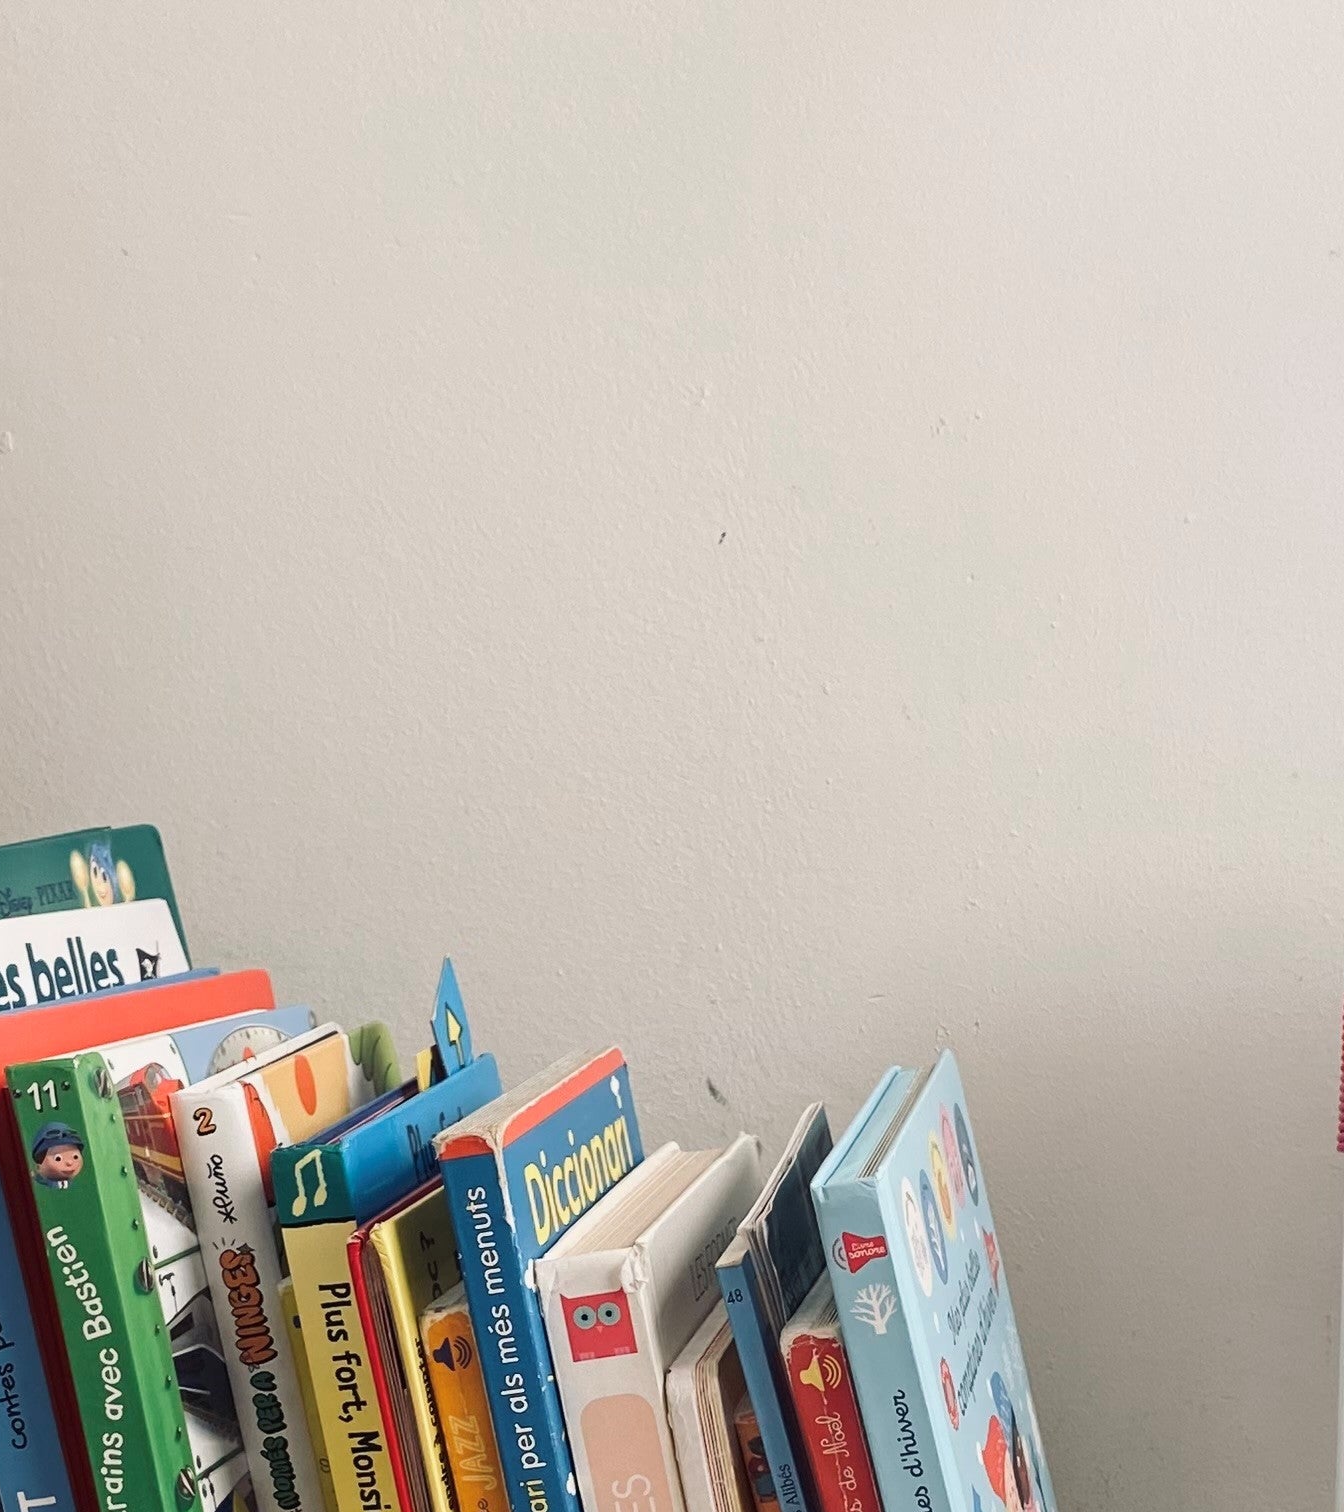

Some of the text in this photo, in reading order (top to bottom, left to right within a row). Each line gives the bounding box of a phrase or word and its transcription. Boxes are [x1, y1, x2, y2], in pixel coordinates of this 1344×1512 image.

[35, 880, 78, 906] PIXAR
[25, 935, 125, 1003] belles
[26, 1078, 58, 1112] 11
[192, 1106, 218, 1137] 2
[523, 1080, 634, 1246] Diccionari
[465, 1185, 506, 1295] menuts
[45, 1224, 114, 1342] Bastien
[318, 1281, 353, 1344] Plus
[726, 1288, 745, 1305] 48
[487, 1303, 520, 1365] més
[99, 1346, 125, 1422] avec
[218, 1248, 302, 1511] NOMÉS PER A NINGES
[331, 1349, 369, 1424] fort,
[500, 1372, 530, 1415] als
[448, 1414, 498, 1491] JAZZ
[513, 1422, 548, 1471] per
[814, 1411, 851, 1458] Noël
[893, 1388, 924, 1478] d'hiver
[778, 1462, 801, 1506] Alibés
[839, 1465, 858, 1491] de
